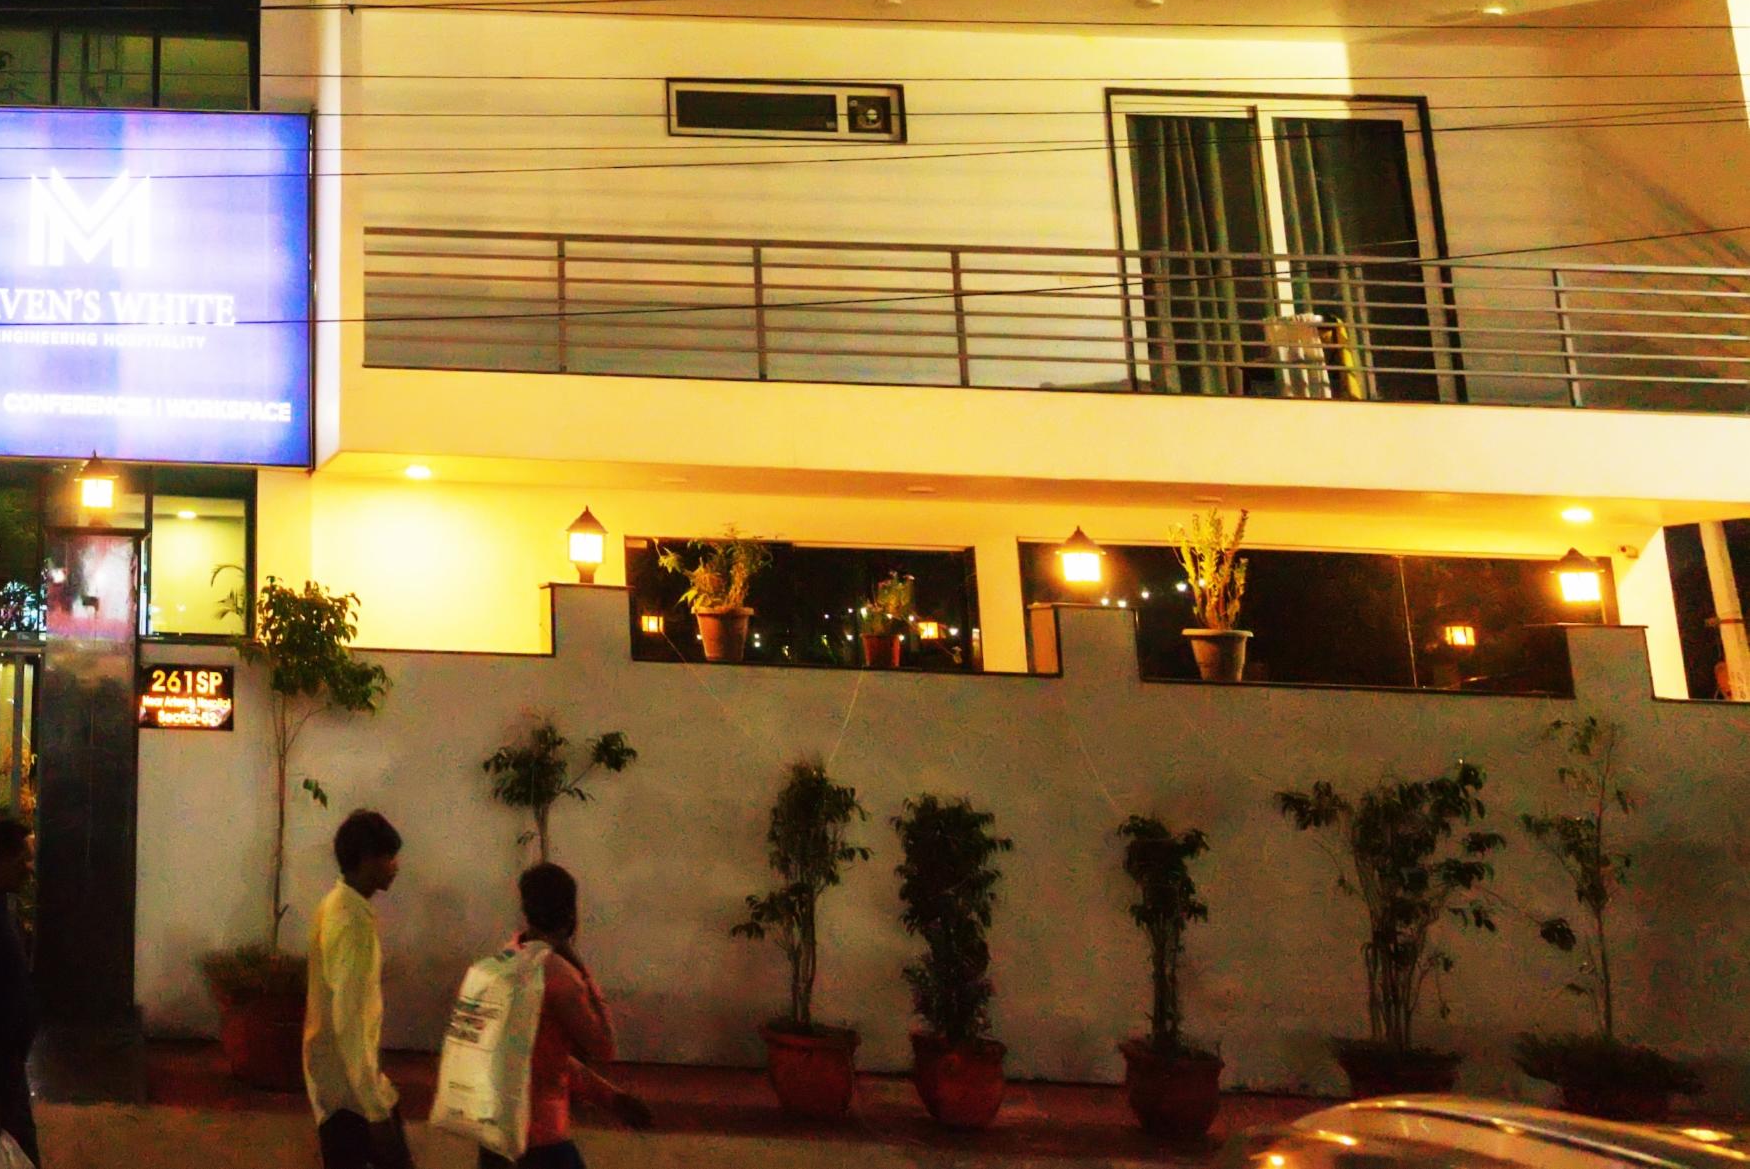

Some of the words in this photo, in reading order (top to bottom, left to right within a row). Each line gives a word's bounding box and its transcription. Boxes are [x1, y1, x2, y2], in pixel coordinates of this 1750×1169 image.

[111, 291, 236, 327] WHITE
[103, 333, 206, 349] HOSPITALITY
[3, 393, 151, 417] CONFERENC
[166, 398, 292, 422] WORKSPACE
[151, 669, 223, 695] 261SP
